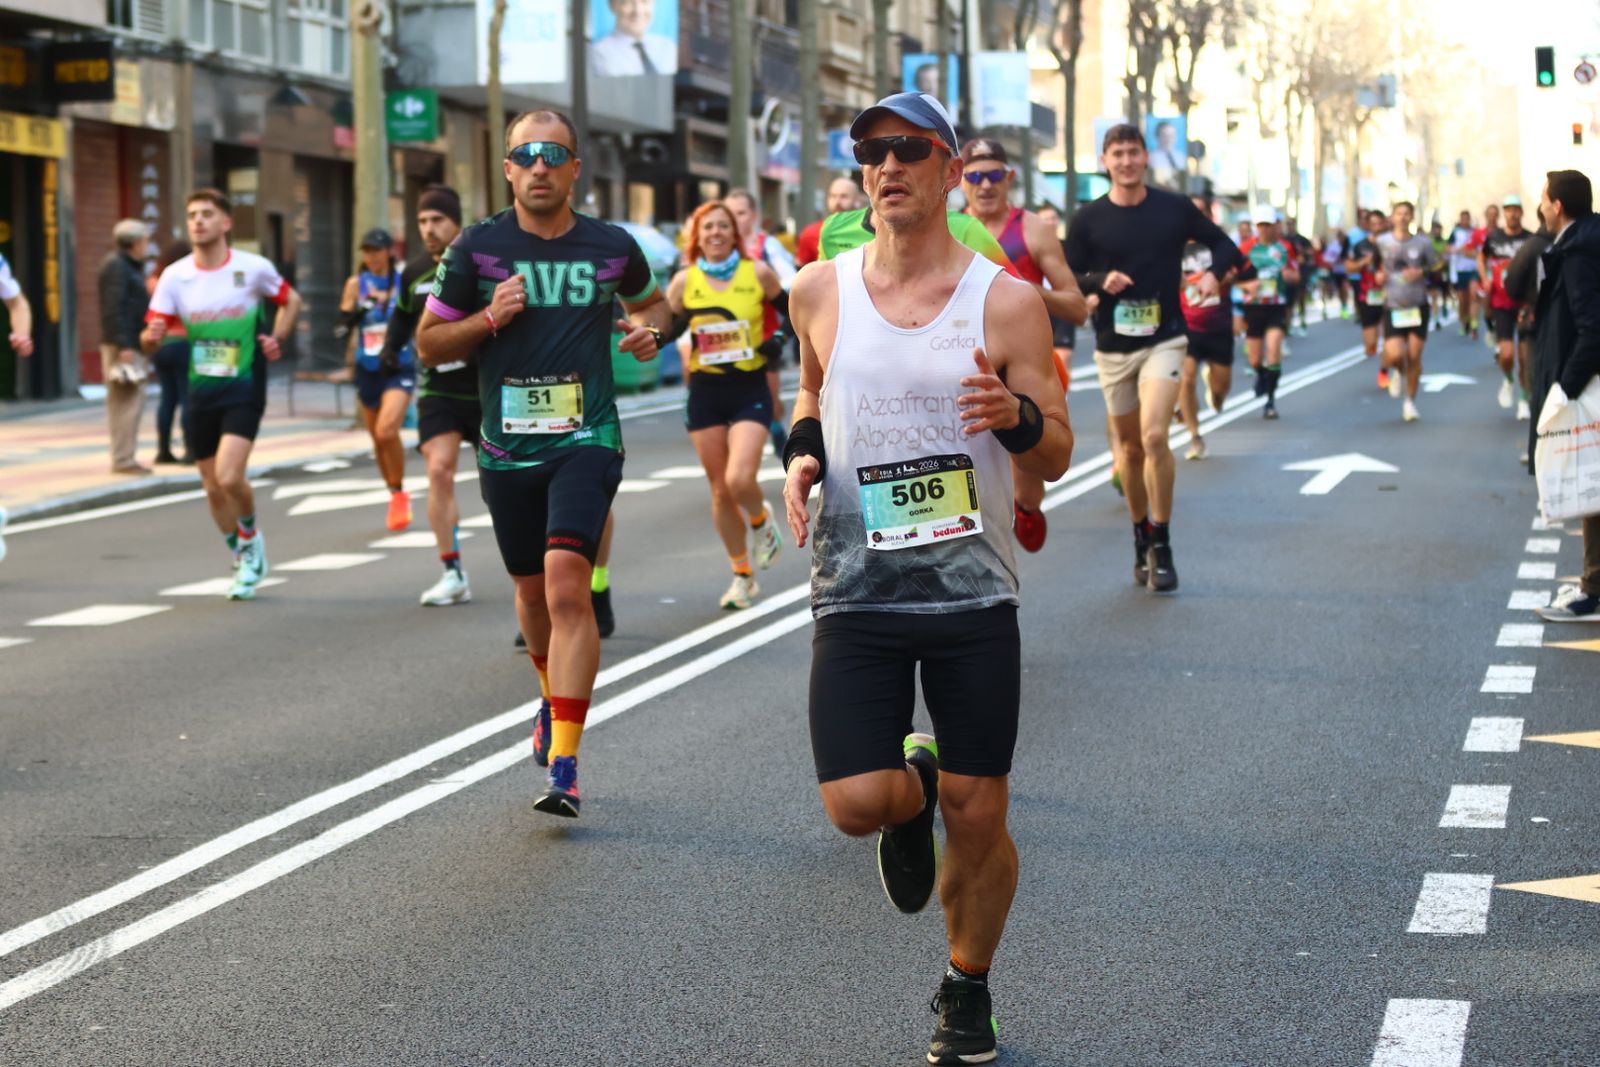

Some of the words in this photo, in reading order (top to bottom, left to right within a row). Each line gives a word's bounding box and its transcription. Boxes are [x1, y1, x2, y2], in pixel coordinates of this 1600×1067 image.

[515, 261, 595, 307] AVS
[930, 335, 976, 351] Gorka
[528, 389, 550, 405] 51
[918, 460, 939, 471] 2026
[892, 478, 945, 506] 506
[909, 506, 934, 517] GORKA
